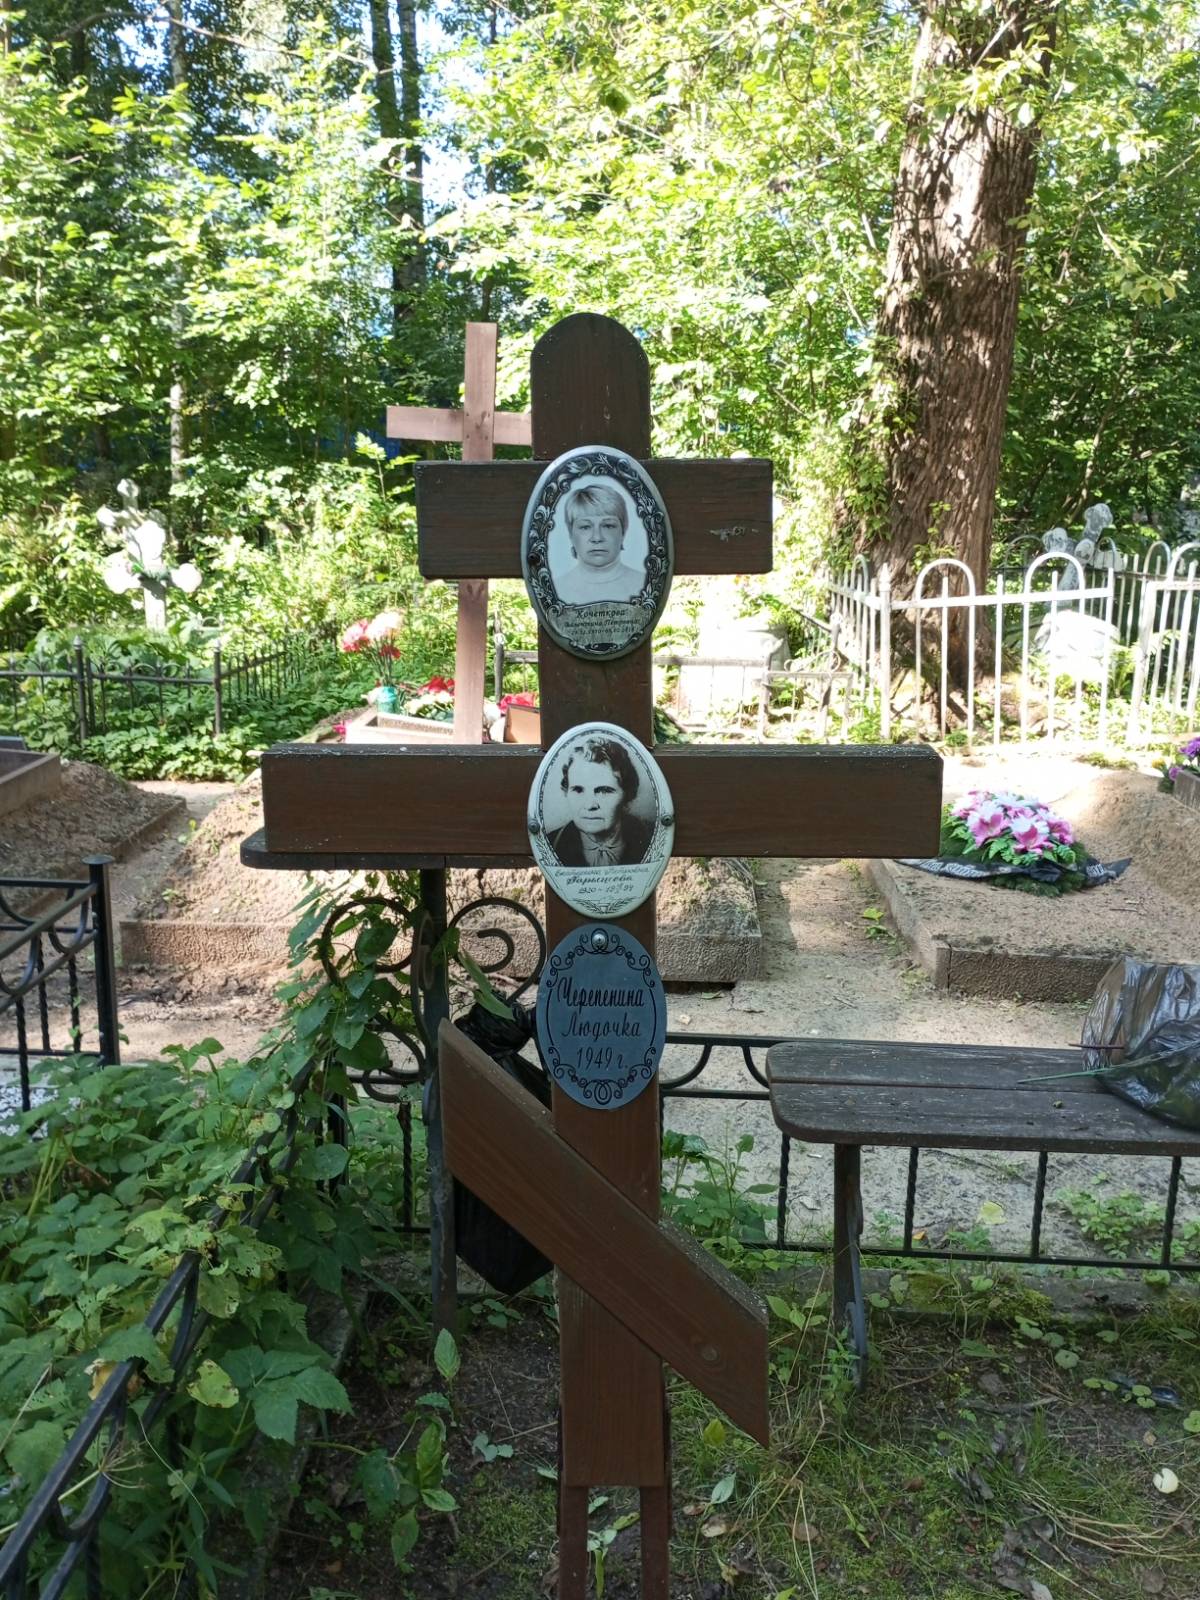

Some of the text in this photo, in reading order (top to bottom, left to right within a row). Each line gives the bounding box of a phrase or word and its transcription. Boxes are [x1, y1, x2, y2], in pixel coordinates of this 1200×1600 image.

[557, 976, 645, 1014] Черепенина
[561, 1011, 642, 1042] Людочка
[577, 1046, 613, 1071] 1949
